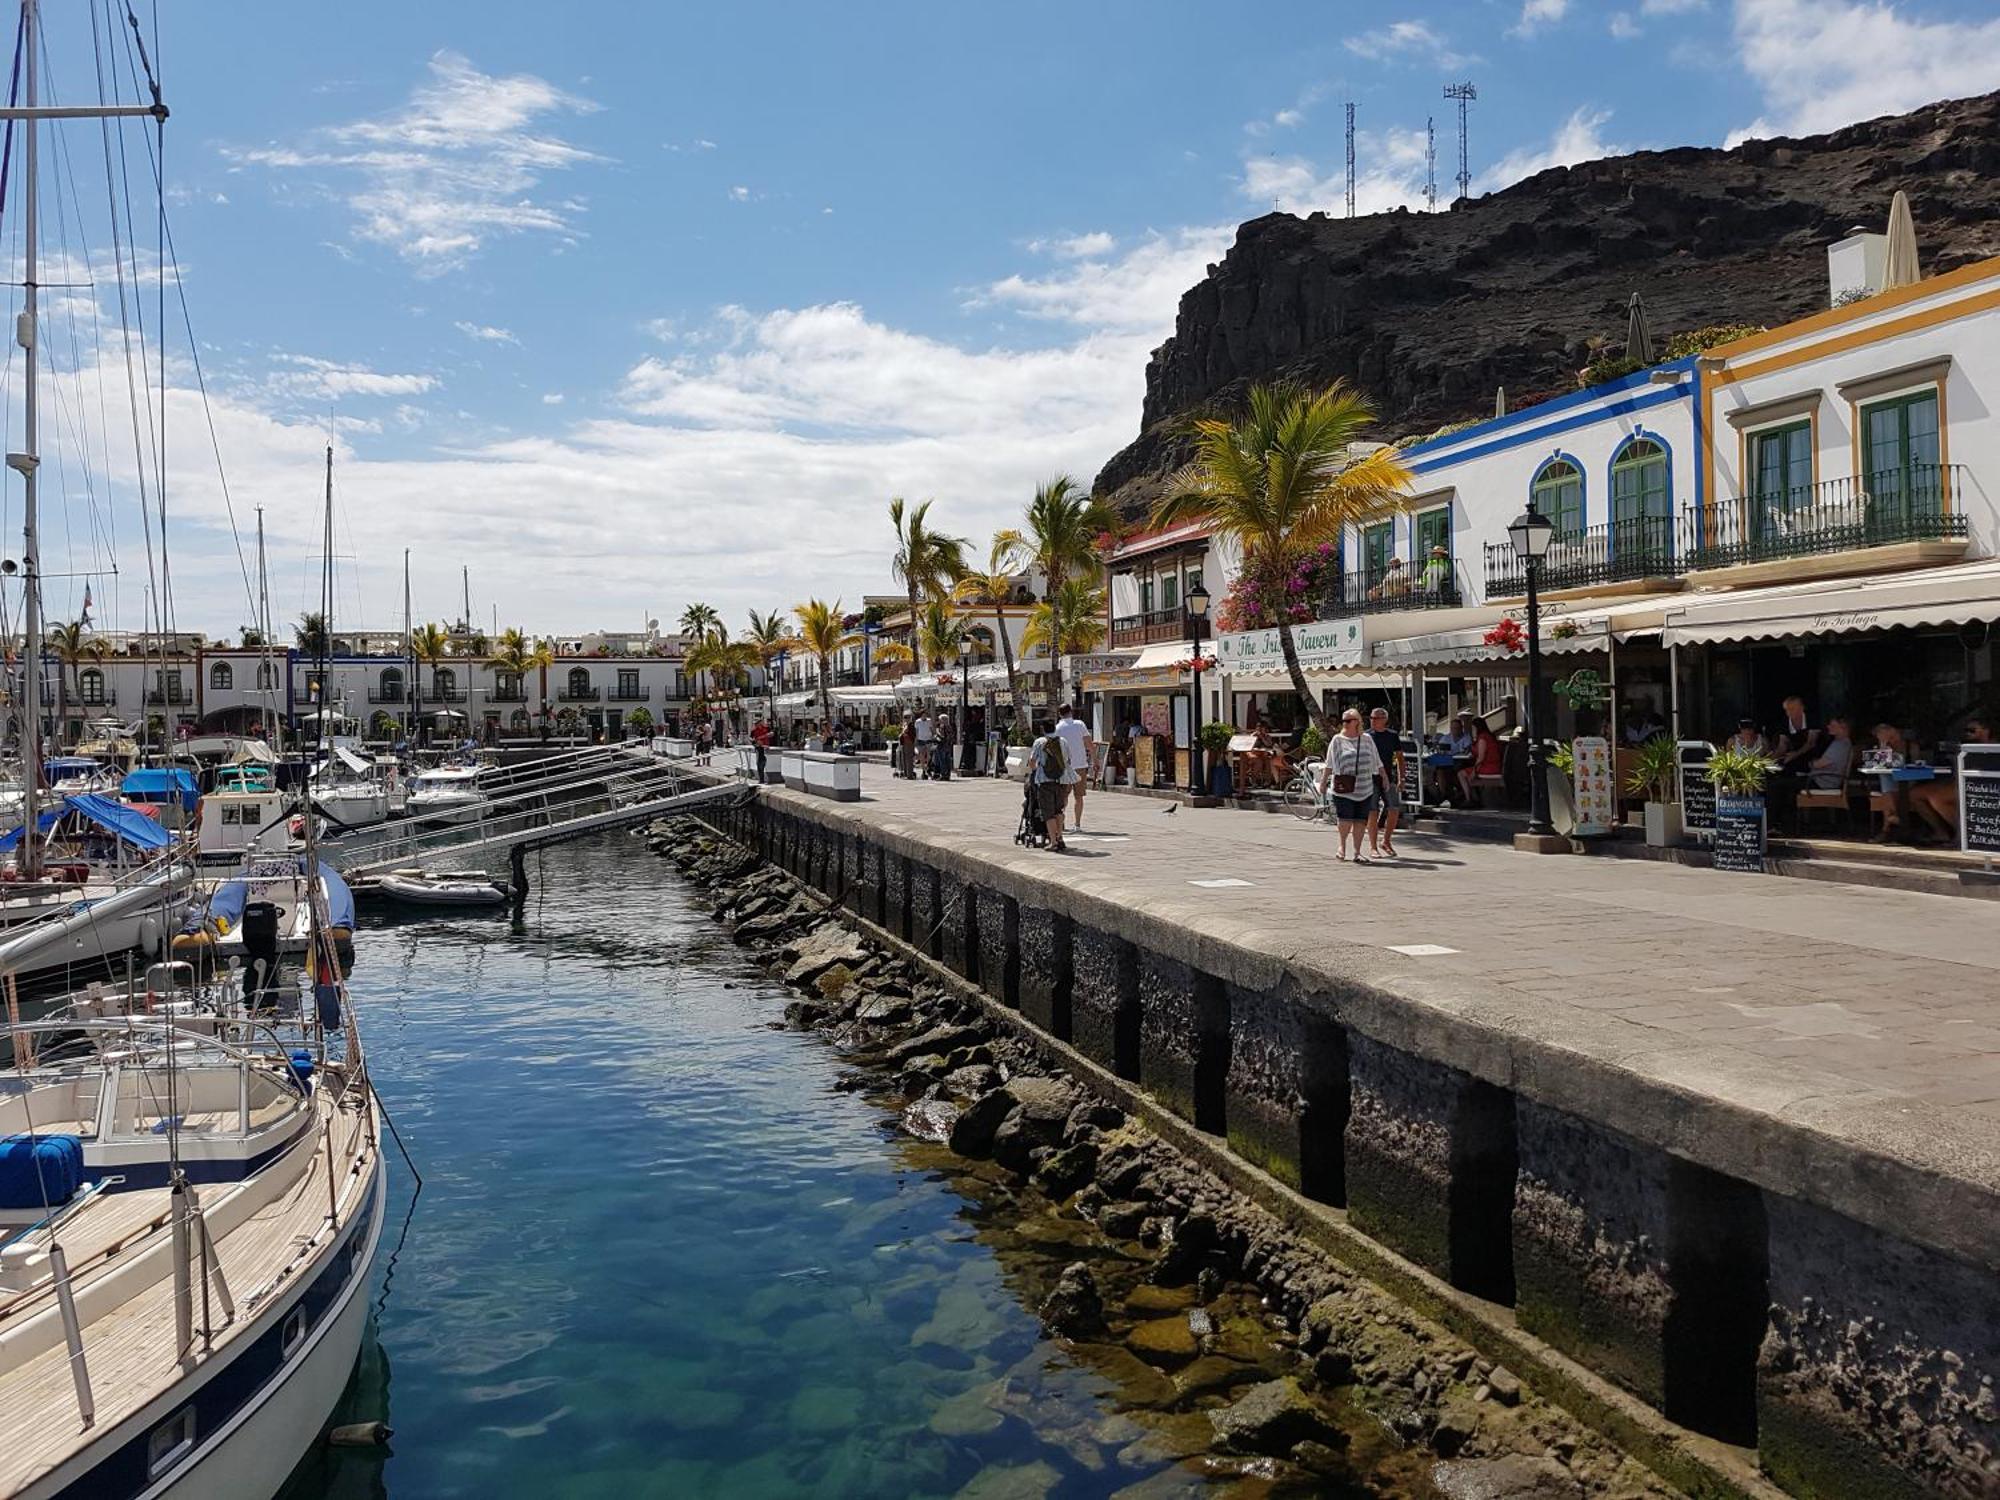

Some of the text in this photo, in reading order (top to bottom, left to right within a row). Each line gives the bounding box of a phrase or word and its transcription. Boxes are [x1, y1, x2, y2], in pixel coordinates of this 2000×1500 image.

[1237, 636, 1256, 656] The
[1297, 629, 1337, 651] Tavern
[1240, 661, 1253, 670] Bar
[1260, 660, 1276, 669] and
